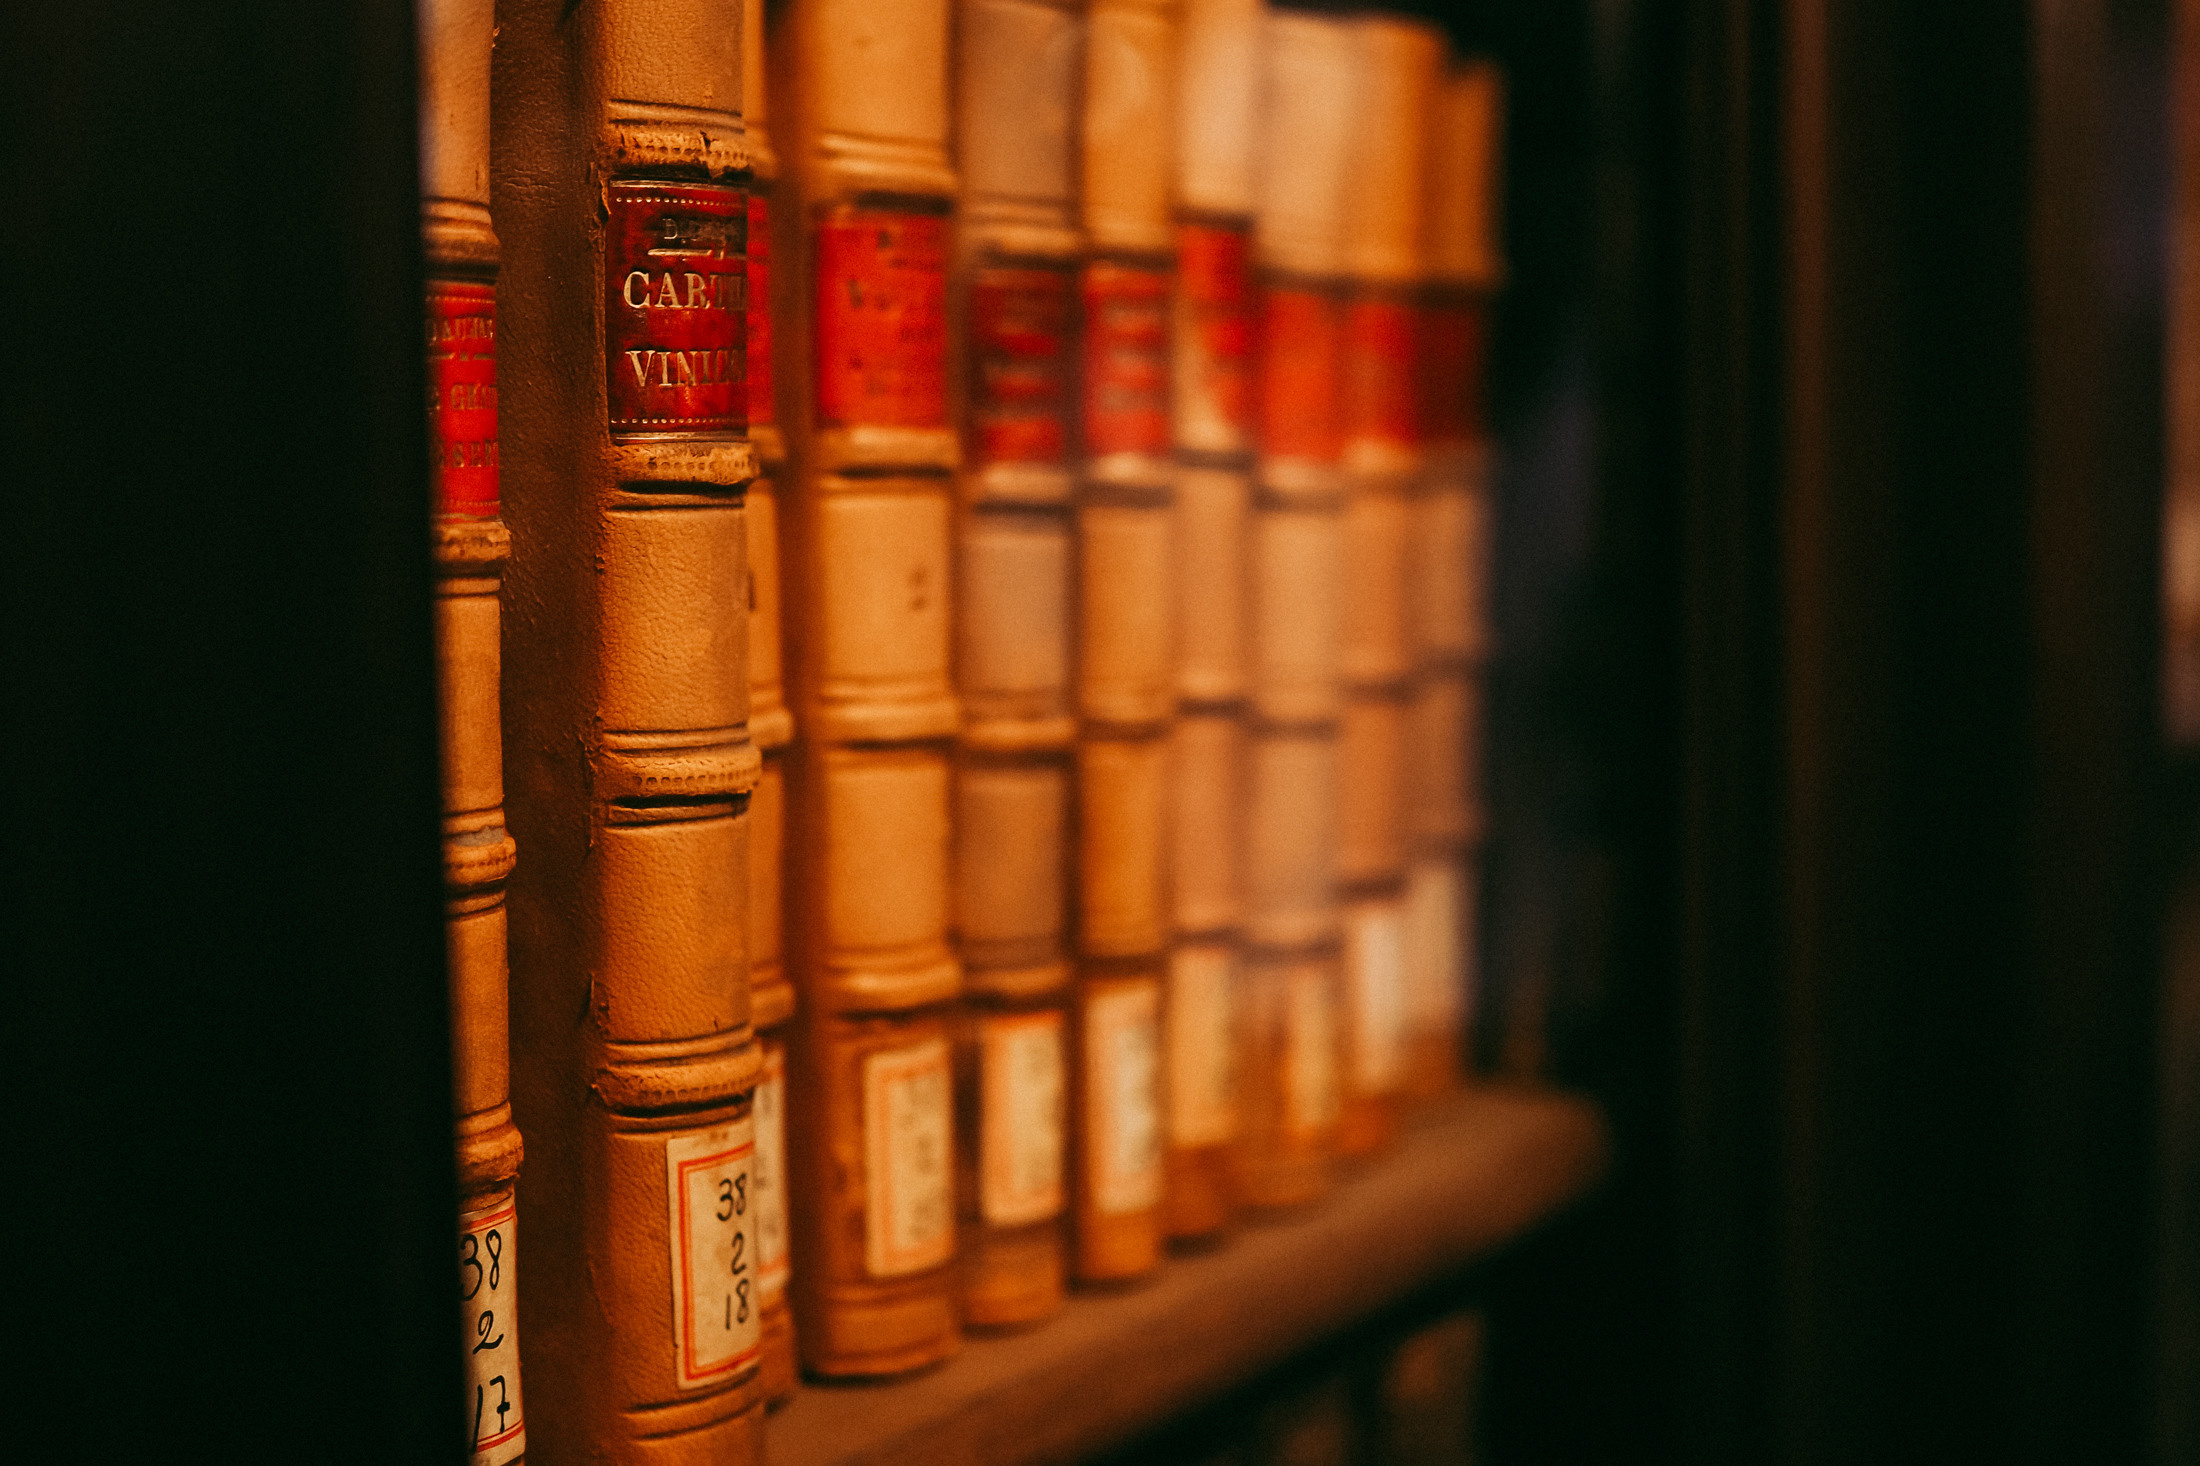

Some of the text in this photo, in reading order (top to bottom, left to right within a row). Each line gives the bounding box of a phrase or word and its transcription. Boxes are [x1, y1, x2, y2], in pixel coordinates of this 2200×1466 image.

[716, 1173, 747, 1221] 38
[460, 1229, 502, 1301] 38
[731, 1232, 747, 1275] 2
[726, 1279, 750, 1330] 18
[473, 1310, 504, 1355] 2
